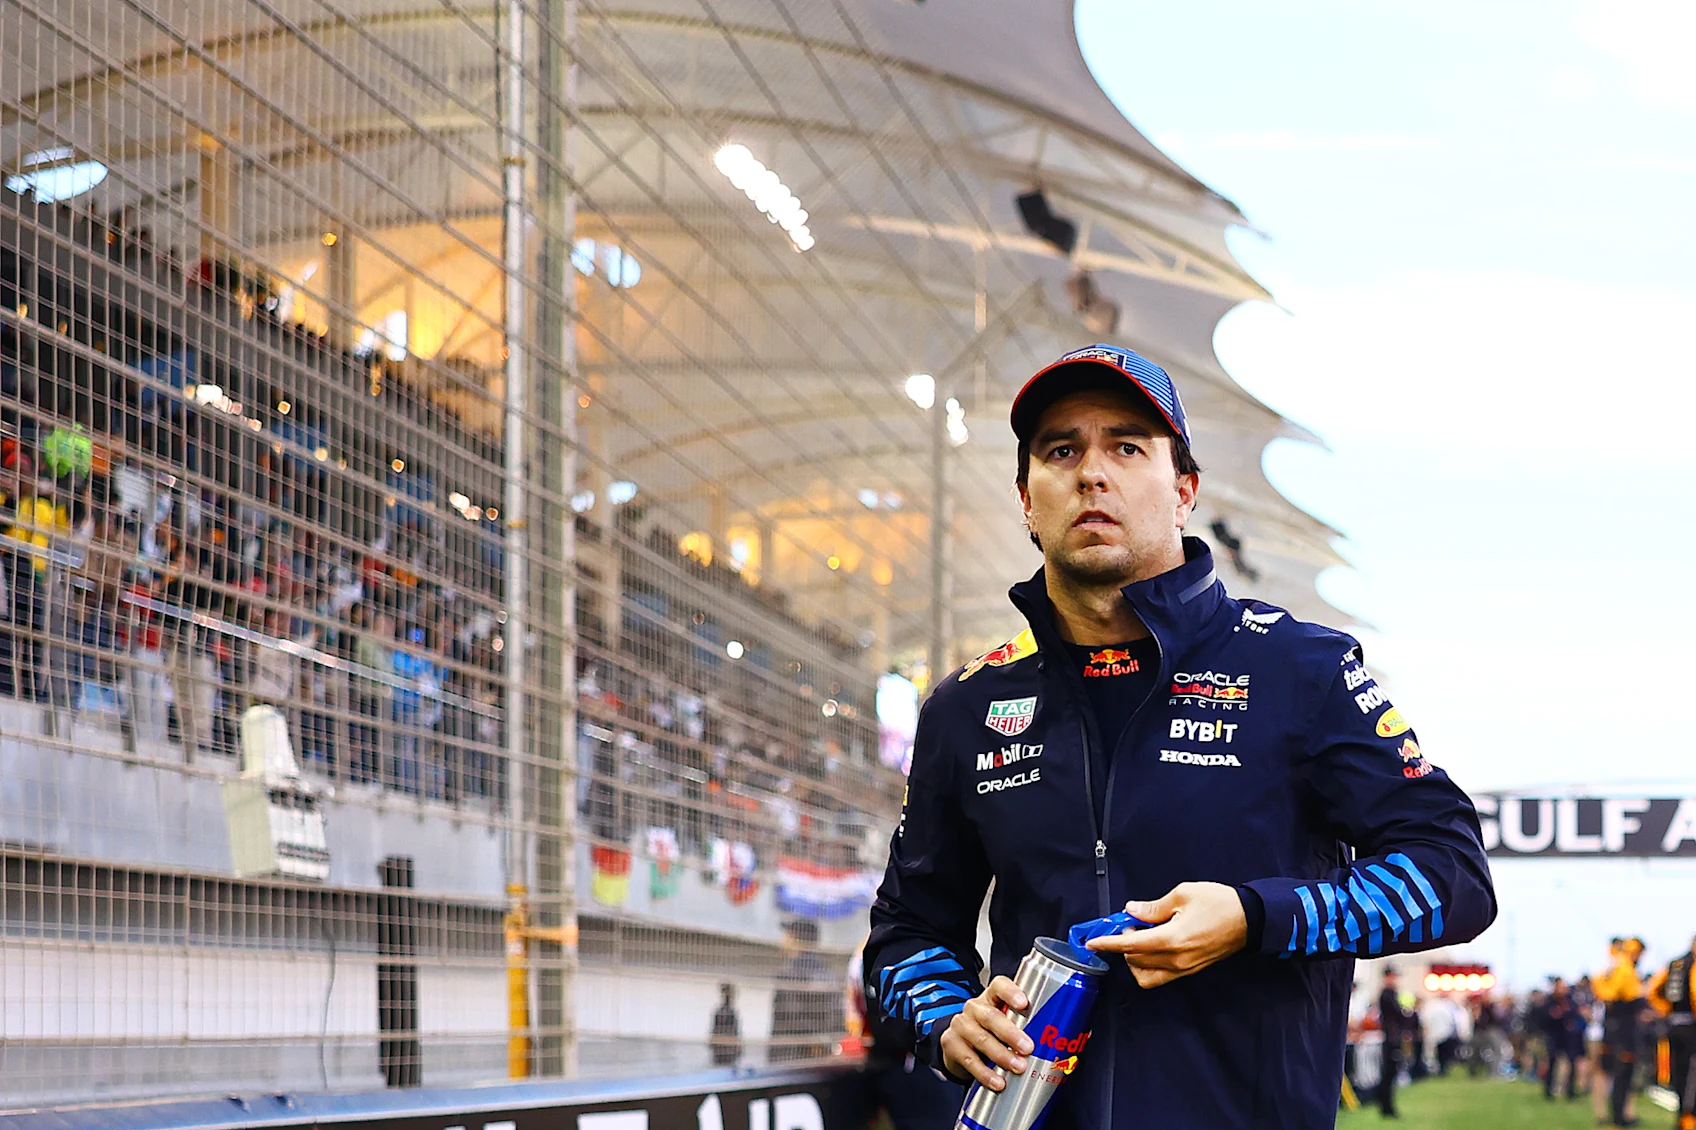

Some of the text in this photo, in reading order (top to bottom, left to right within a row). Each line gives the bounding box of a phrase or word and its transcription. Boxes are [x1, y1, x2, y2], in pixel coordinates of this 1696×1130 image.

[1083, 659, 1140, 678] Red Bull
[1173, 671, 1251, 687] ORACLE
[1171, 683, 1213, 698] Red Bull
[993, 702, 1033, 716] TAG
[1168, 698, 1249, 711] RACING
[988, 717, 1032, 735] HEUER
[1169, 718, 1239, 743] BYBIT
[976, 743, 1021, 771] Mobil
[1158, 749, 1242, 767] HONDA
[976, 768, 1041, 795] ORACLE
[1039, 1024, 1083, 1053] Red
